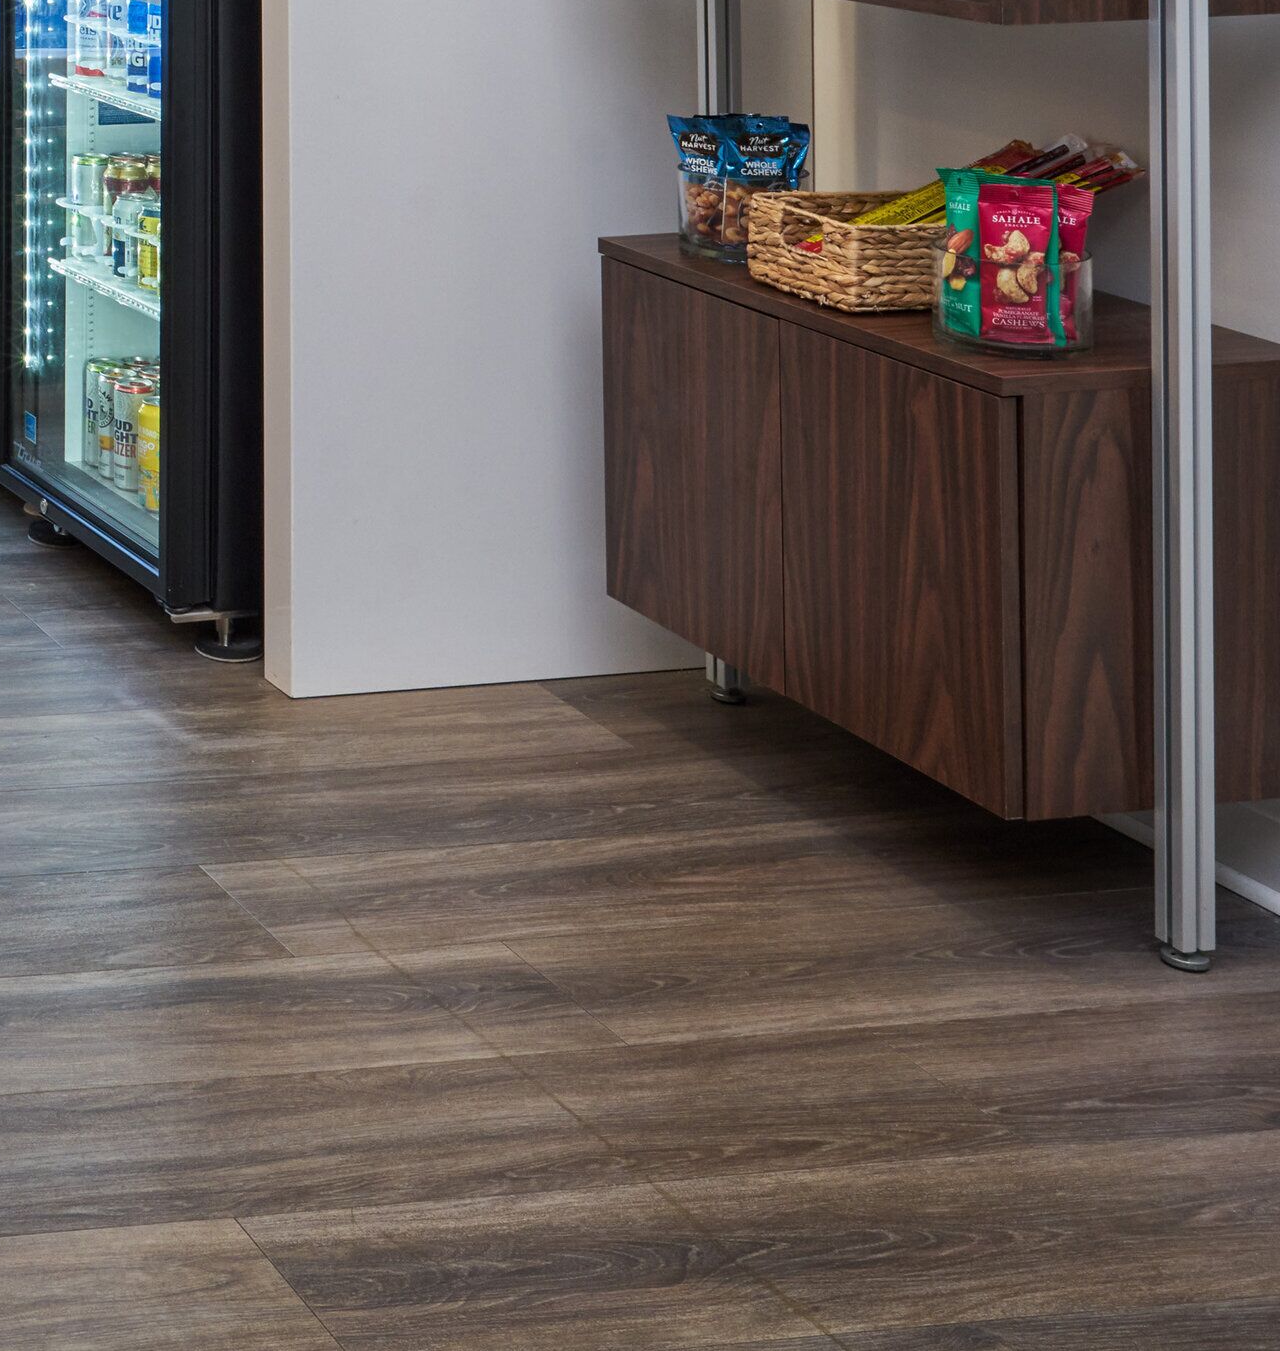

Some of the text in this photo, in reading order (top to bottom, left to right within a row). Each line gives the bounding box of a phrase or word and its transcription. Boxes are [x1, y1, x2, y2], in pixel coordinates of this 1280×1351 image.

[740, 144, 780, 153] HARVEST
[745, 160, 777, 171] WHOLE
[740, 167, 783, 177] CASHEWS
[991, 213, 1042, 226] SAHALE
[991, 317, 1045, 329] CASHEWS
